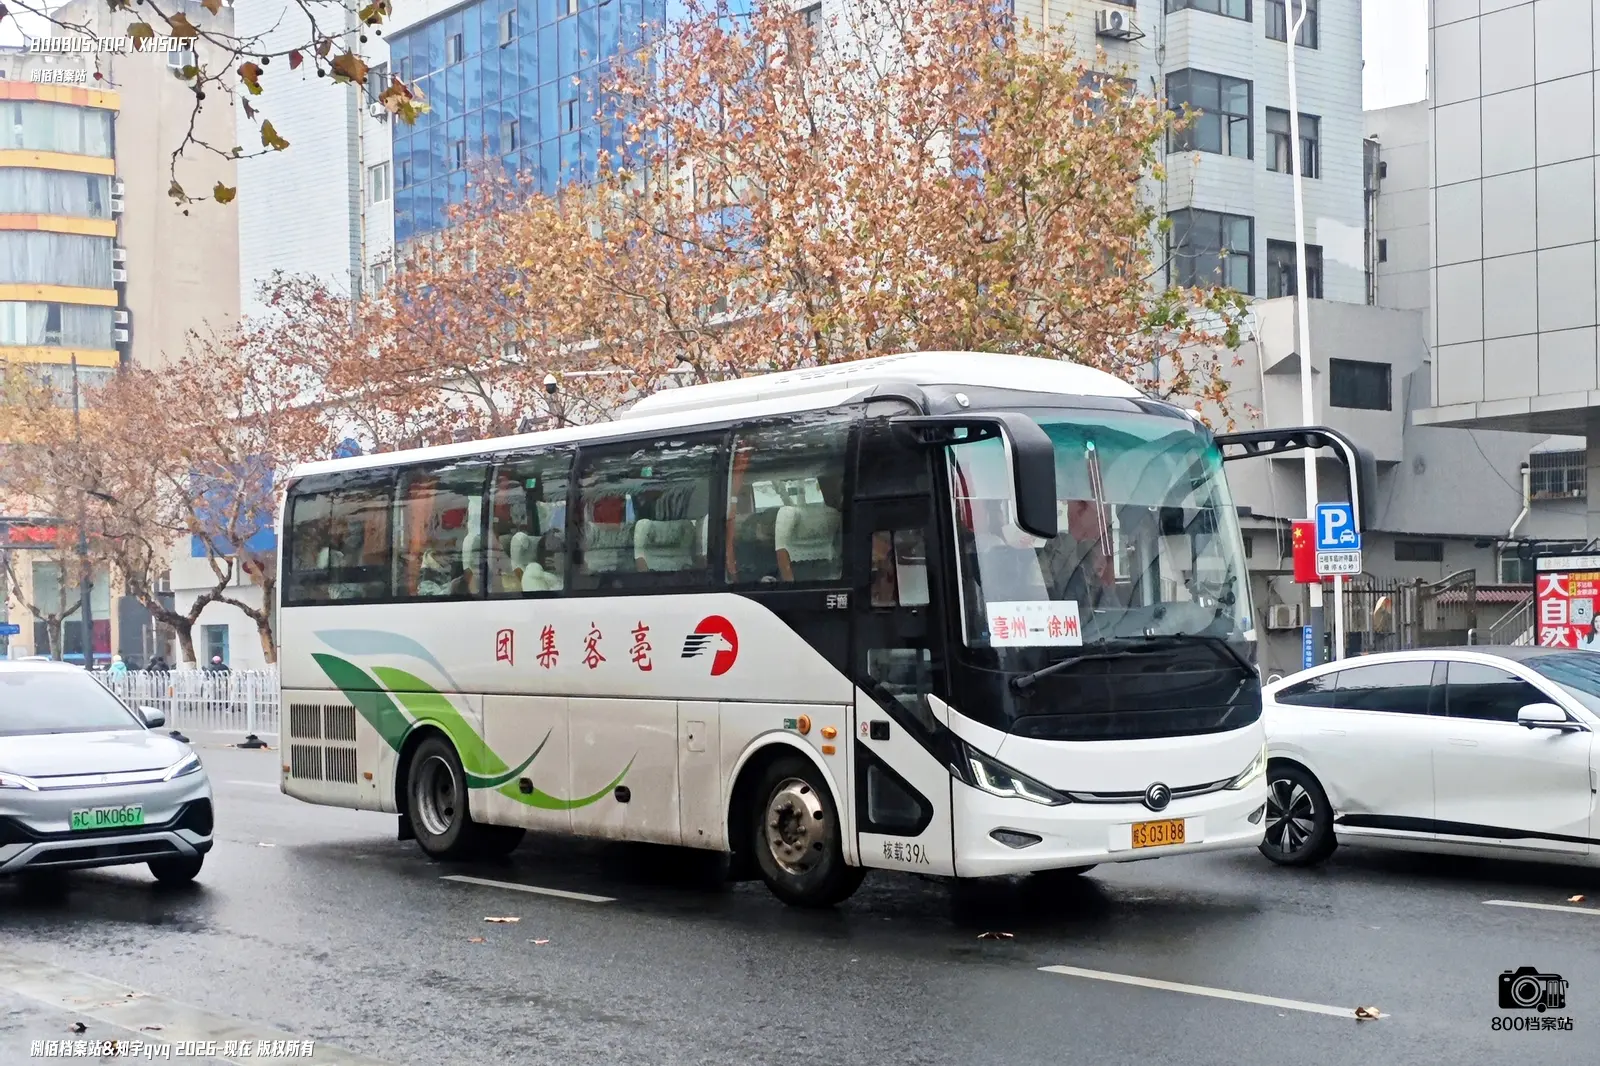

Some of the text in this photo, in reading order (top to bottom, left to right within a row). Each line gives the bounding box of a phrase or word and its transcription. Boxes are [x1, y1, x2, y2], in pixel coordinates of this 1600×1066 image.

[1320, 508, 1347, 545] P
[826, 593, 848, 609] 宇通
[1539, 573, 1570, 647] 大自然
[882, 840, 930, 865] 核载39人
